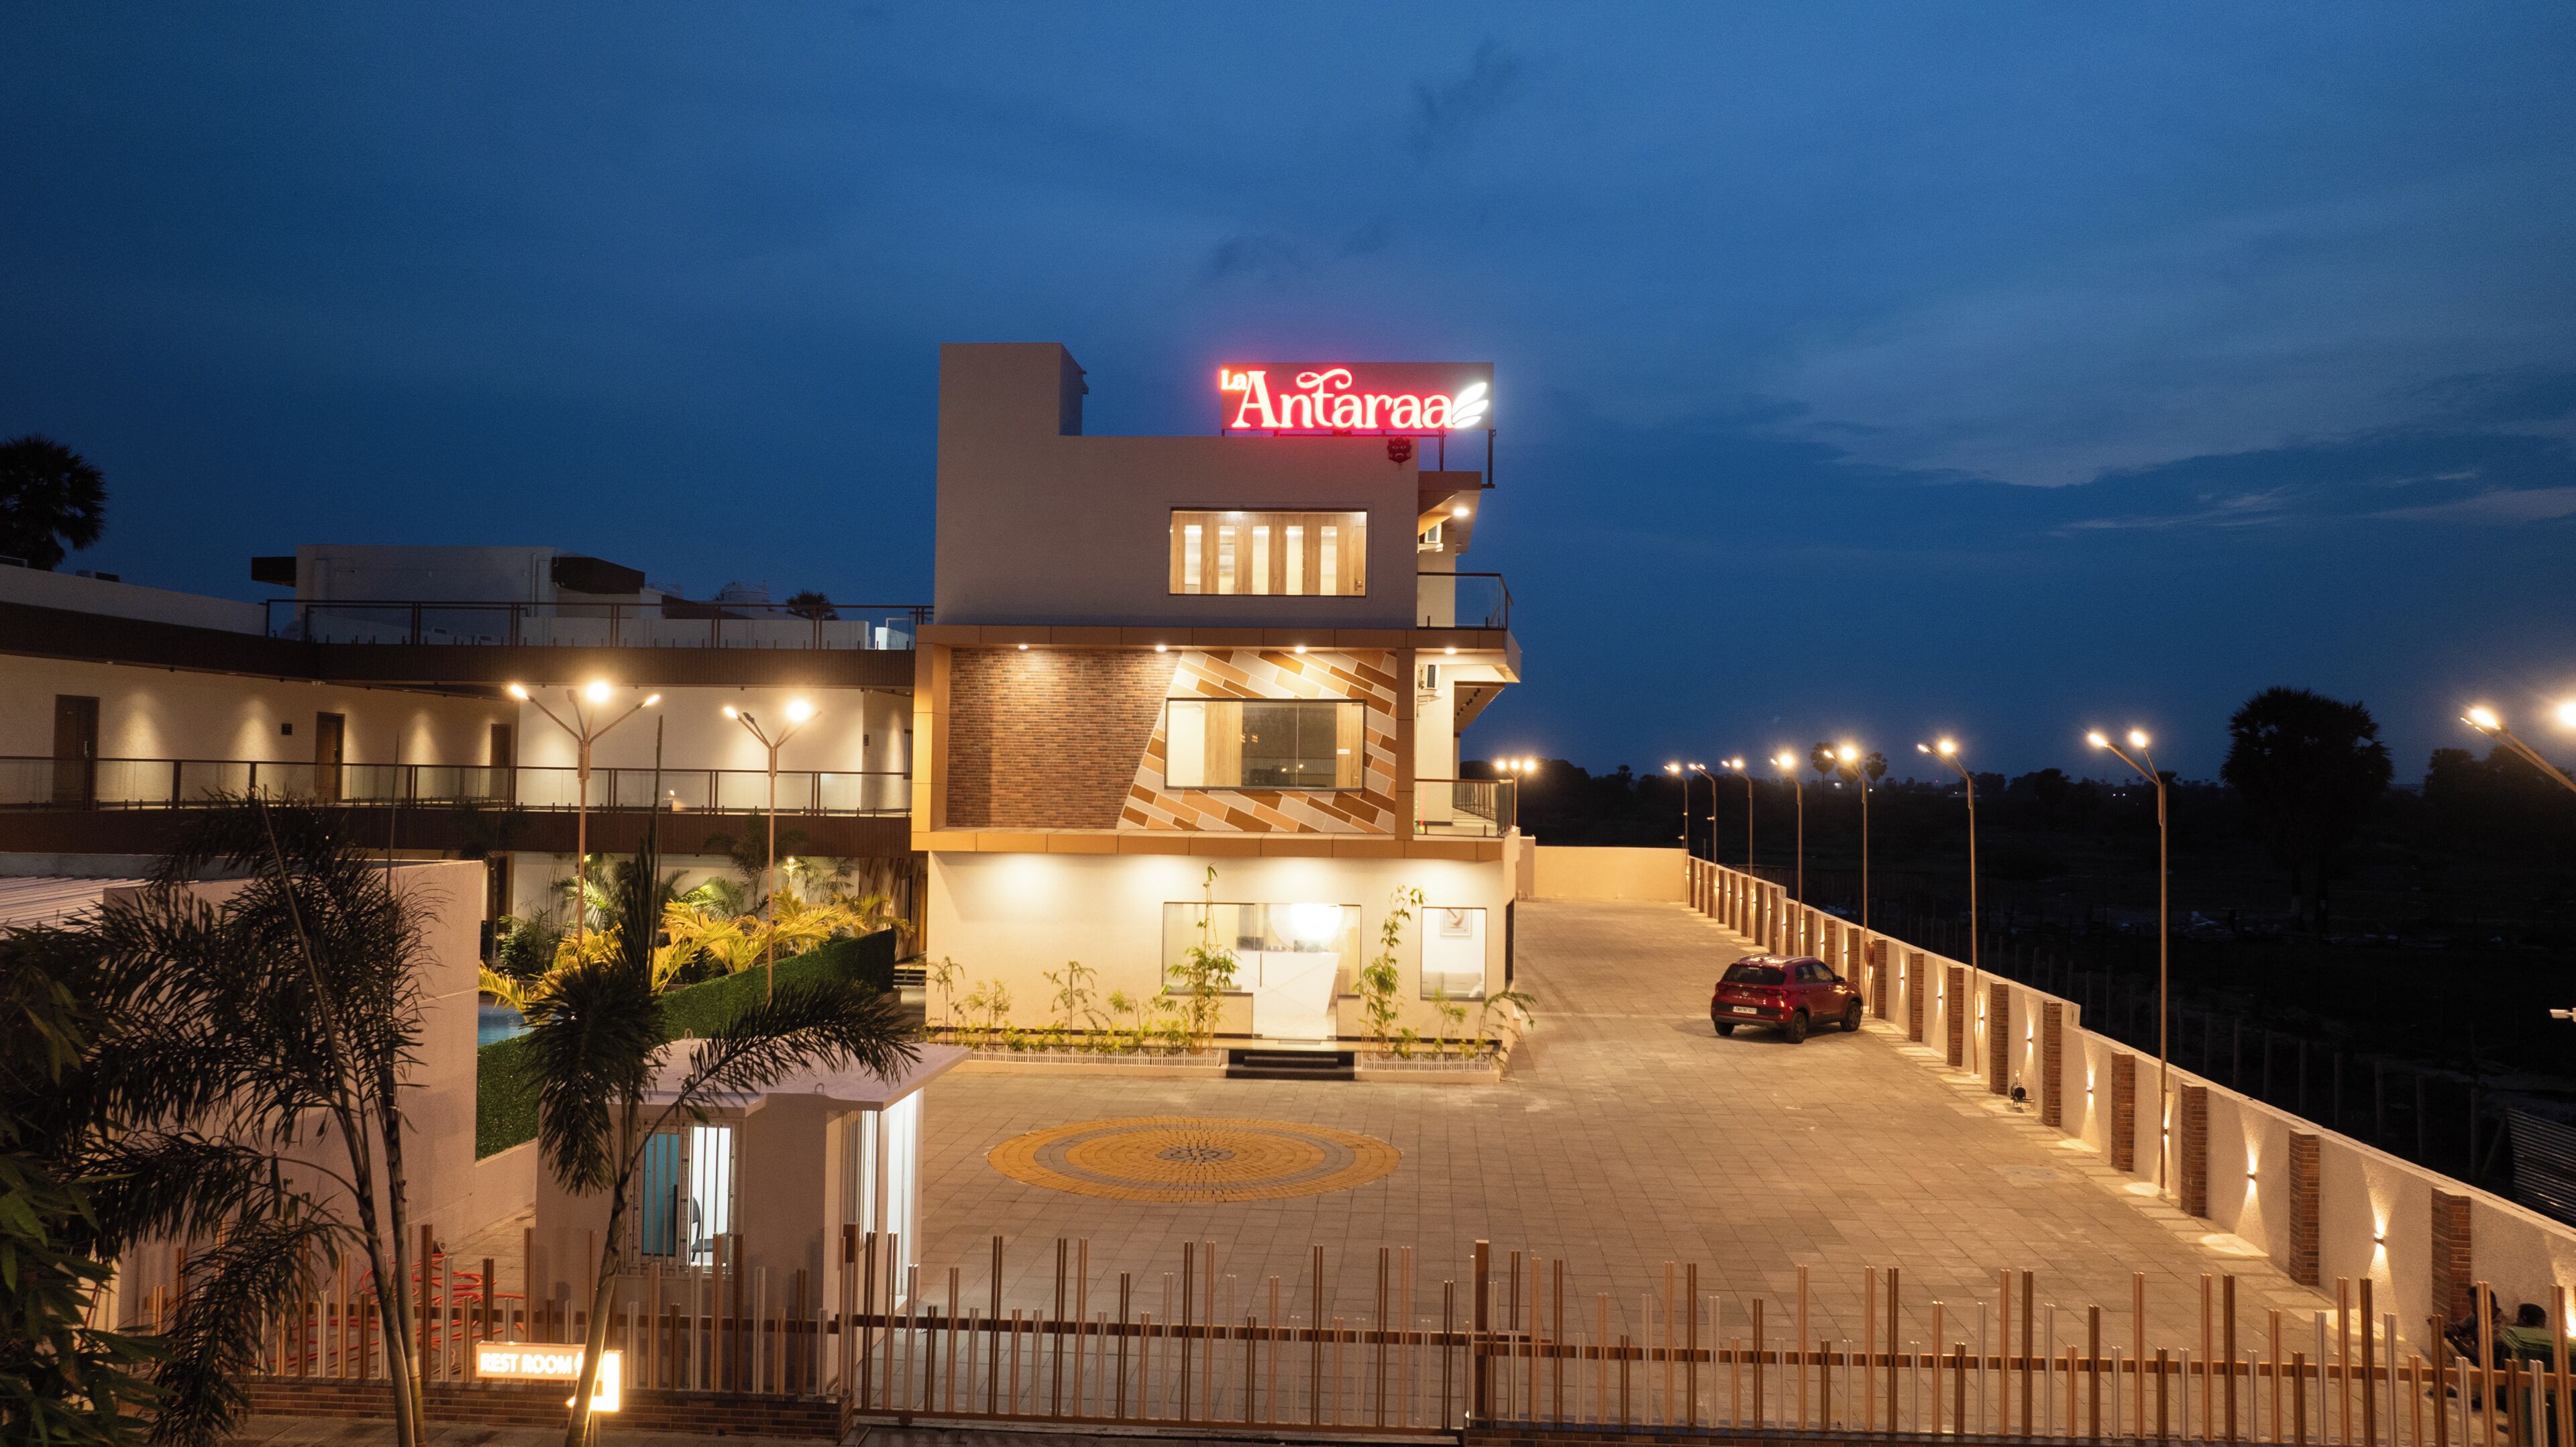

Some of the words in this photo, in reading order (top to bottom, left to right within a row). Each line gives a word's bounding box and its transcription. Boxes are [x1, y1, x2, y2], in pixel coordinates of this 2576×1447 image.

[1221, 370, 1247, 390] La
[1232, 368, 1454, 429] Antaraa
[480, 1352, 519, 1373] REST
[522, 1354, 572, 1375] ROOM
